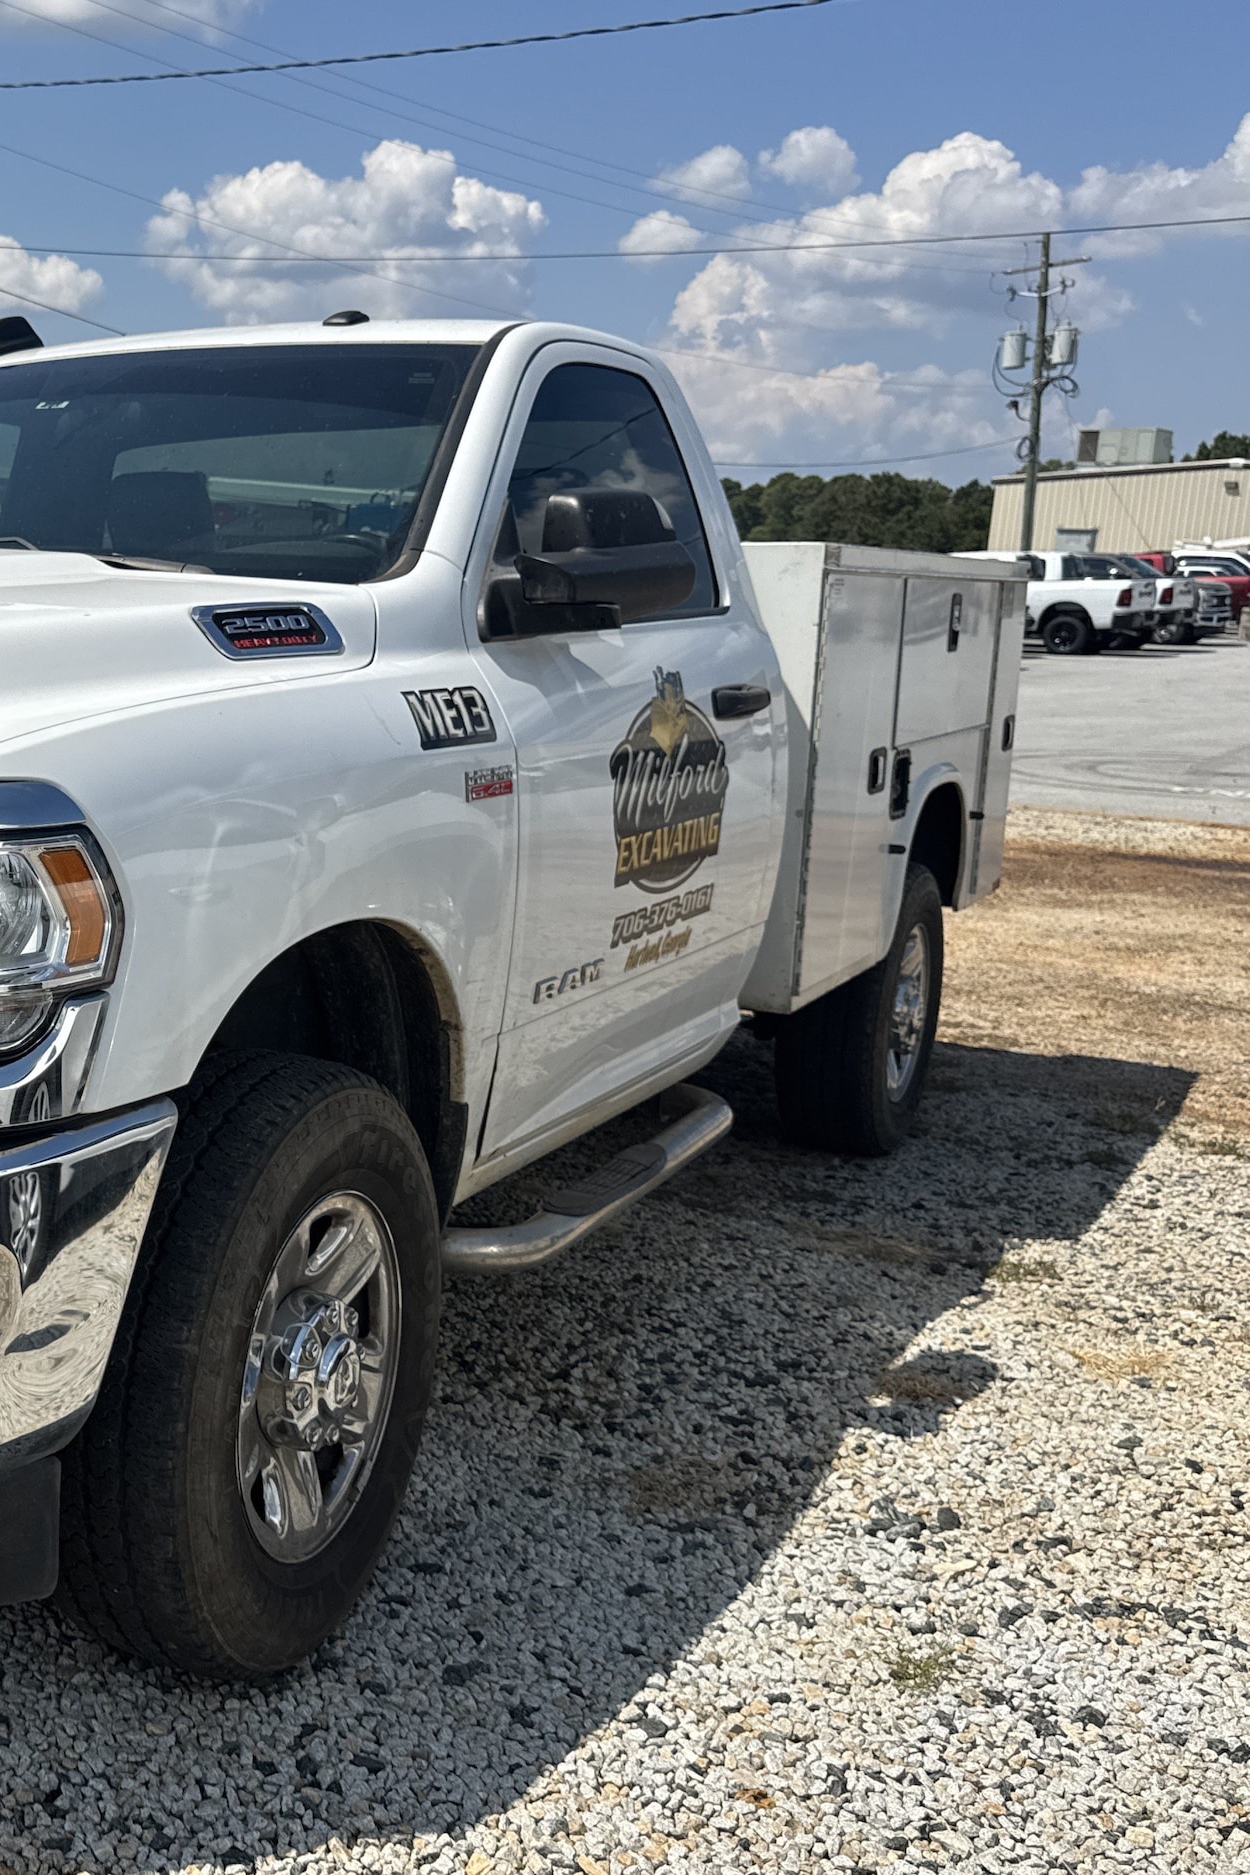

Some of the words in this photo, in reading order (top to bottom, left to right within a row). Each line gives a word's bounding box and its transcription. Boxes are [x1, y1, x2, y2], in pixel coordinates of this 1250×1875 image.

[222, 614, 310, 634] 2500
[233, 637, 280, 649] HEAVY
[282, 634, 318, 645] DUTY
[405, 687, 496, 745] ME13
[612, 734, 726, 827] Milford
[617, 812, 720, 874] EXCAVATING
[610, 884, 714, 949] 706-376-0161
[533, 959, 605, 1004] RAM
